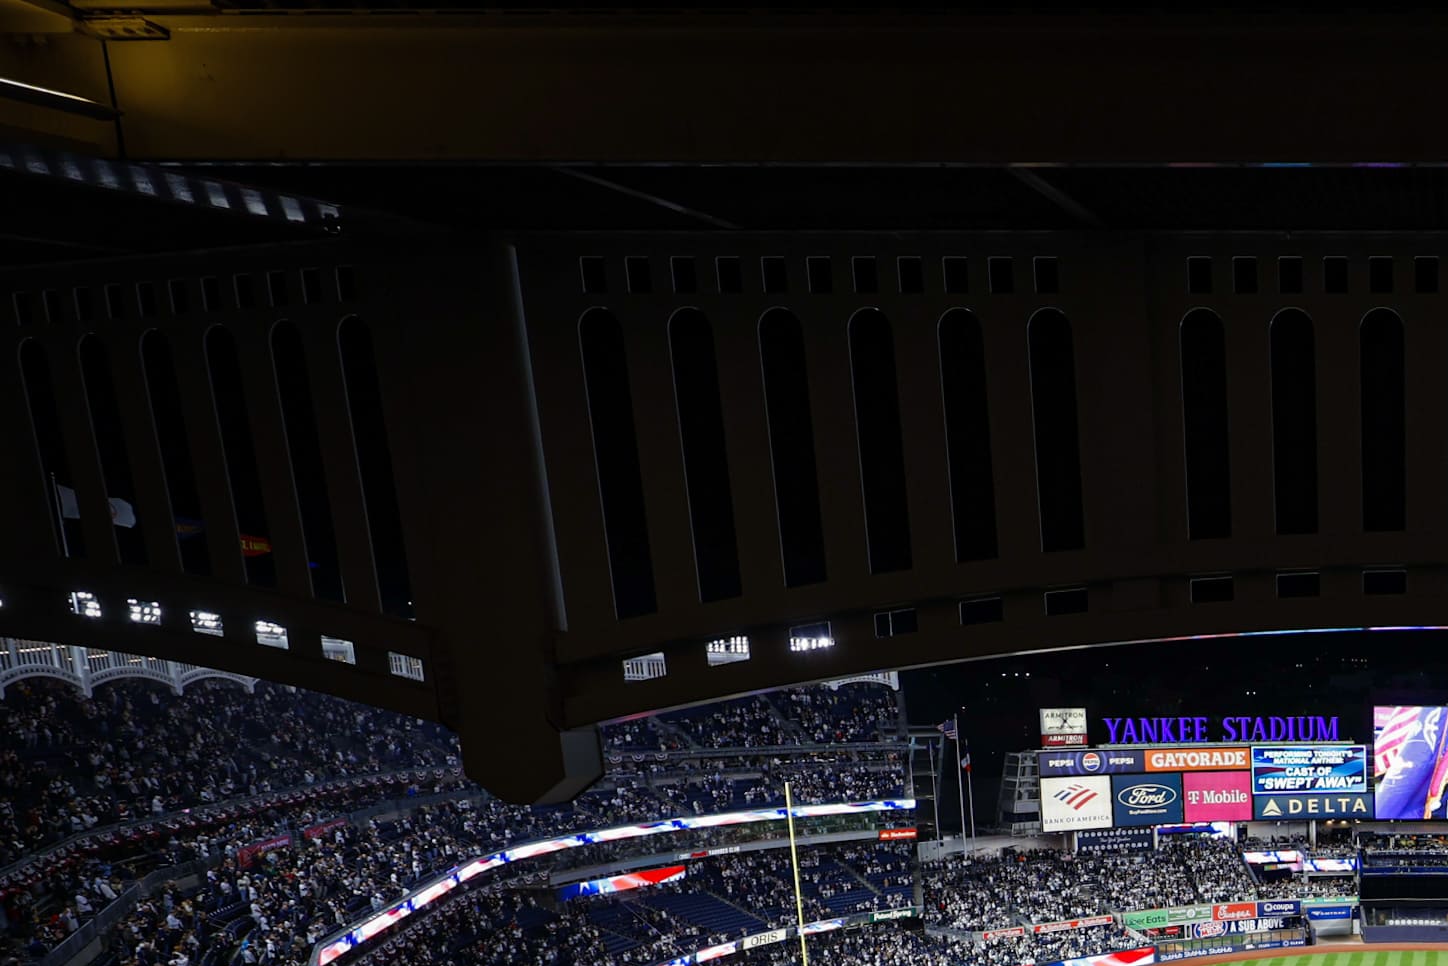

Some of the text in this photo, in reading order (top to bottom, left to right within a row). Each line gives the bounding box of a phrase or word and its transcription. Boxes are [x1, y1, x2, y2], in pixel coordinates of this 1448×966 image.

[1104, 716, 1339, 743] YANKEE STADIUM
[1048, 734, 1083, 743] ARMITRON
[1049, 759, 1074, 768] PEPSI
[1109, 757, 1134, 765] PEPSI
[1151, 752, 1246, 767] GATORADE
[1286, 767, 1332, 776] CAST OF
[1128, 788, 1166, 804] Ford
[1202, 790, 1248, 804] Mobile
[1289, 798, 1367, 814] DELTA
[1044, 817, 1064, 825] BANK
[1271, 903, 1294, 911] coupa
[1145, 915, 1166, 924] Eats
[1230, 919, 1284, 932] A SUB ABOVE
[751, 932, 778, 946] ORIS
